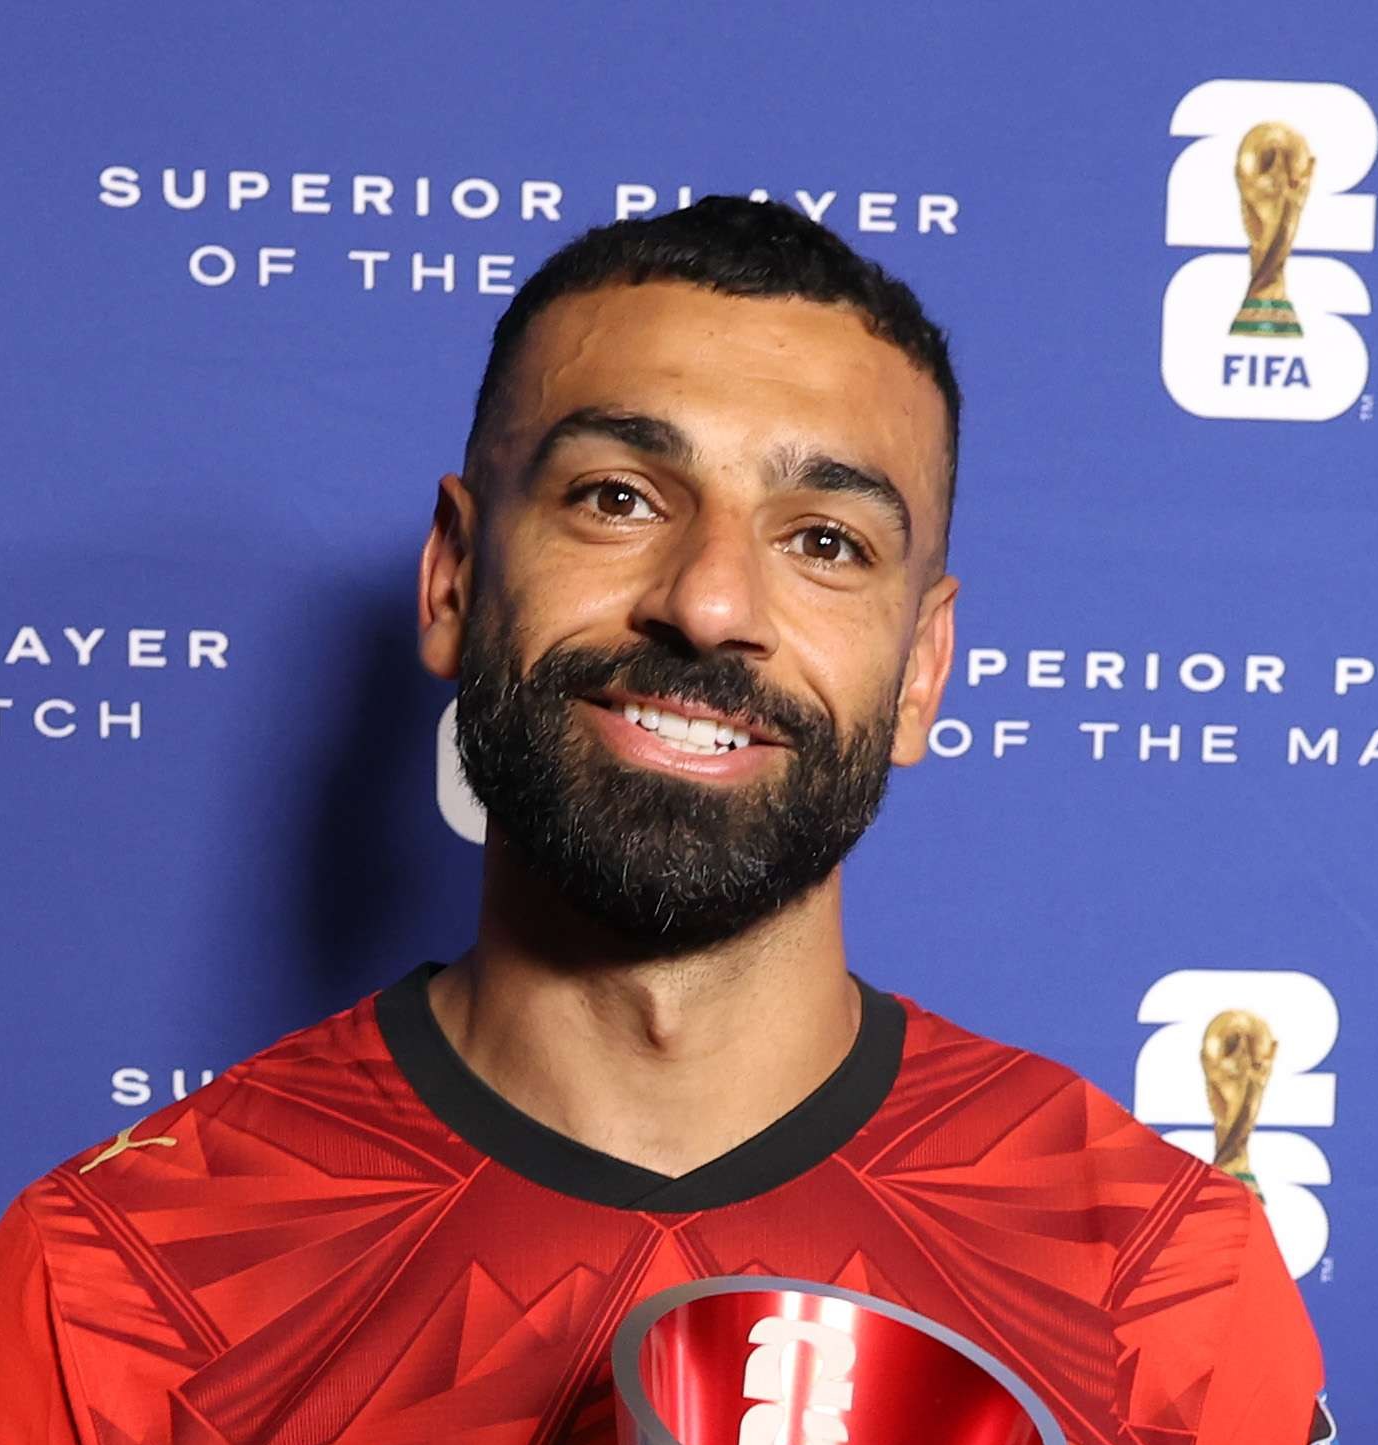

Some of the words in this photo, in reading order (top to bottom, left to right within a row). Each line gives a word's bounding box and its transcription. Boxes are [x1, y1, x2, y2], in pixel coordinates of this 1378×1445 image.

[99, 166, 562, 221] SUPERIOR
[616, 184, 958, 234] PYER
[189, 245, 296, 286] OF
[348, 251, 515, 294] THE
[1224, 356, 1309, 386] FIFA
[968, 649, 1285, 693] PERIOR
[928, 718, 1030, 759] OF
[1079, 722, 1237, 762] THE
